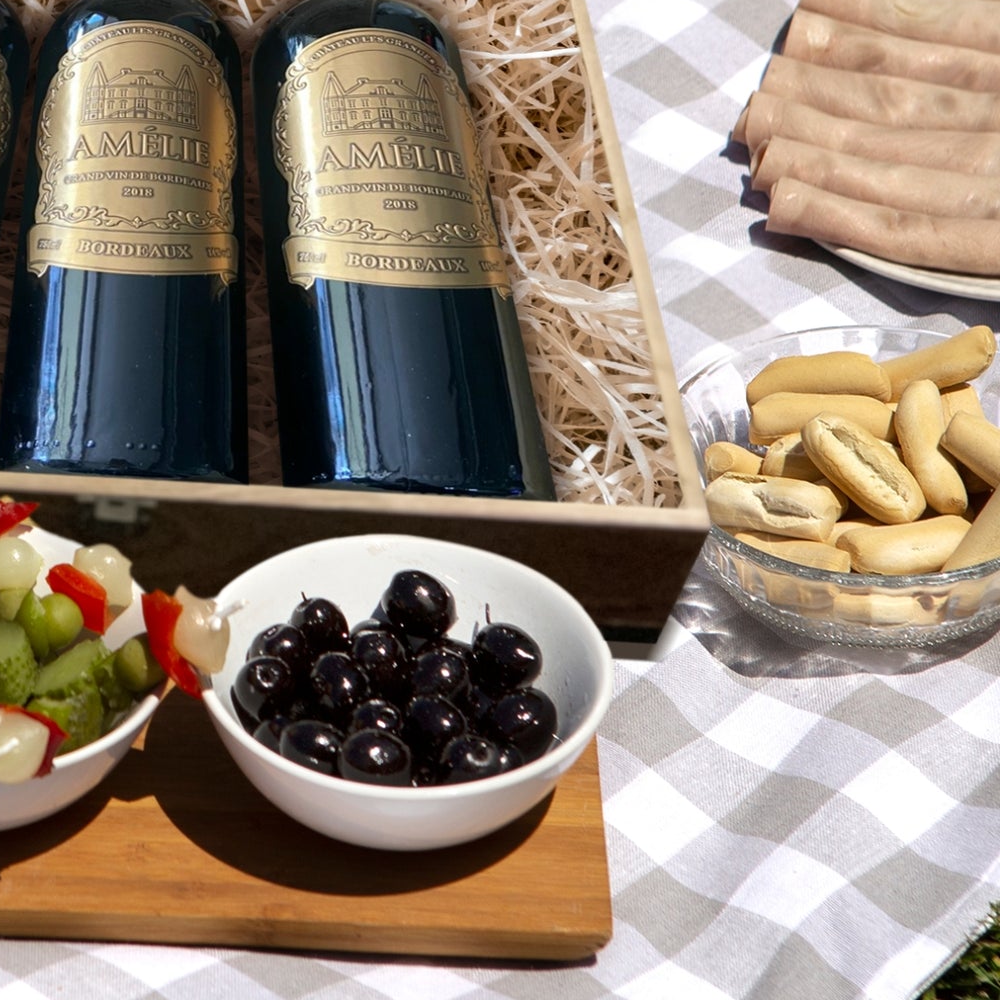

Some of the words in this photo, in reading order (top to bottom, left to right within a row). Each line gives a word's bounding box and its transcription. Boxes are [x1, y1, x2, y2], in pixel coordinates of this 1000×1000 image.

[66, 126, 211, 168] AMÉLIE
[316, 137, 467, 181] AMÉLIE
[105, 170, 129, 180] VIN
[129, 170, 149, 181] DE
[149, 171, 212, 192] BORDEAUX
[121, 186, 154, 198] 2018
[361, 182, 387, 193] VIN
[387, 182, 408, 193] DE
[408, 183, 474, 204] BORDEAUX
[383, 198, 418, 211] 2018
[78, 238, 193, 260] BORDEAUX
[346, 252, 470, 273] BORDEAUX
